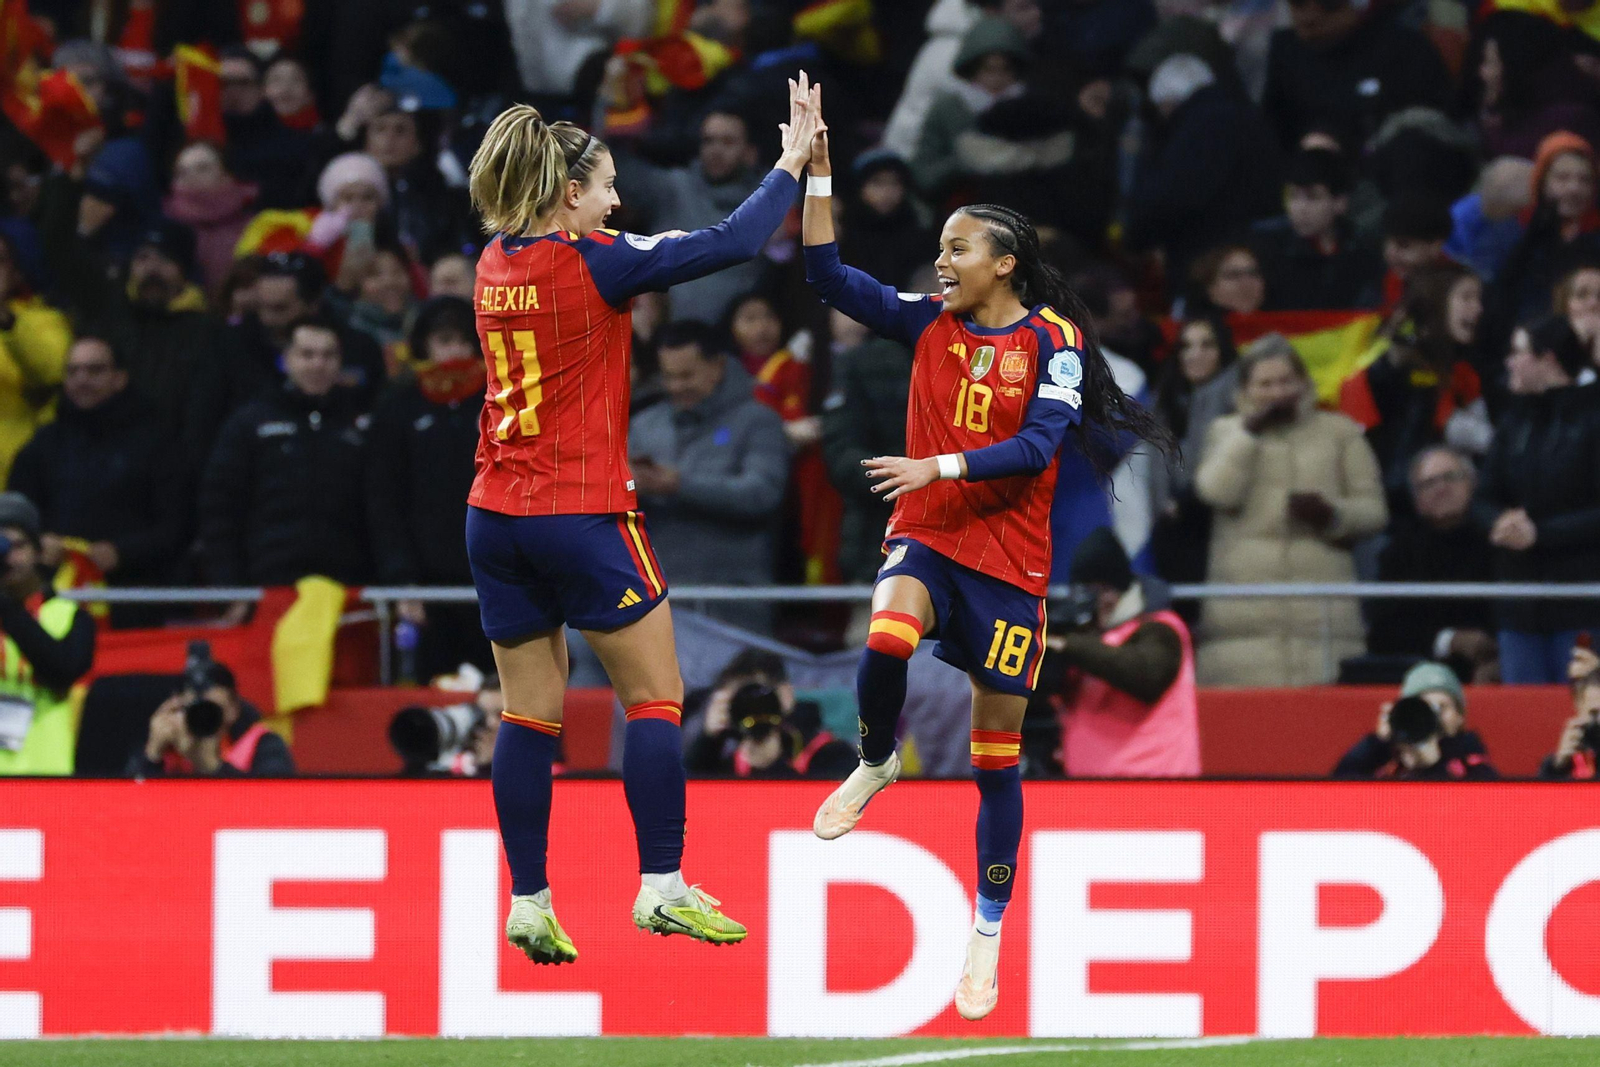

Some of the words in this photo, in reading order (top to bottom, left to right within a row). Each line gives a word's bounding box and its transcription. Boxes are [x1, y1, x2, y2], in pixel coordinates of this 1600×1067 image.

[481, 285, 540, 311] ALEXIA
[486, 330, 543, 440] 11
[952, 377, 993, 433] 18
[984, 618, 1032, 677] 18
[208, 828, 602, 1039] EL
